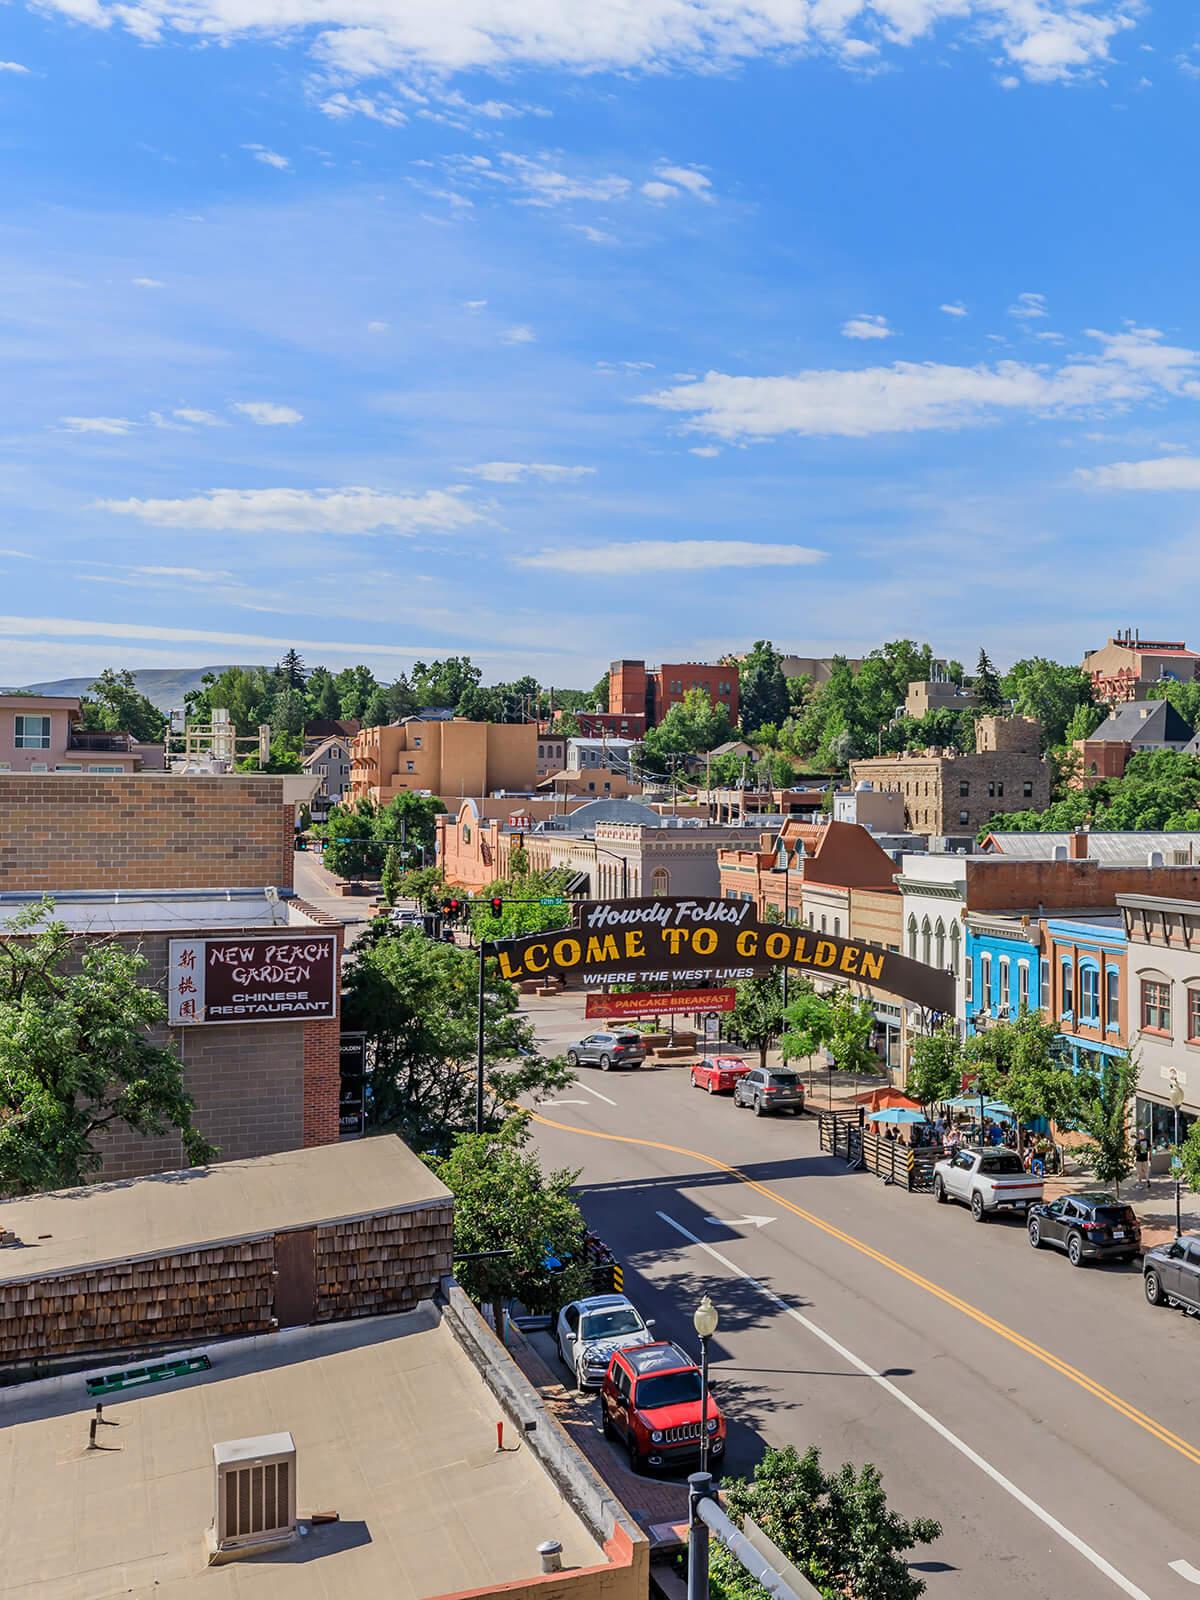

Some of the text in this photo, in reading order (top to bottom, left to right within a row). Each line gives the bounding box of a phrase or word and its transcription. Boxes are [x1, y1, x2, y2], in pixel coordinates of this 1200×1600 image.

[587, 901, 750, 928] Howdy Folks!
[209, 943, 330, 967] NEW PEACH
[661, 927, 719, 956] TO
[735, 929, 886, 981] GOLDEN
[231, 965, 311, 986] GARDEN
[583, 967, 754, 985] WHERE THE WEST LIVES
[232, 991, 309, 1003] CHINESE
[615, 995, 730, 1008] PANCAKE BREAKFAST
[209, 1001, 330, 1015] RESTAURANT
